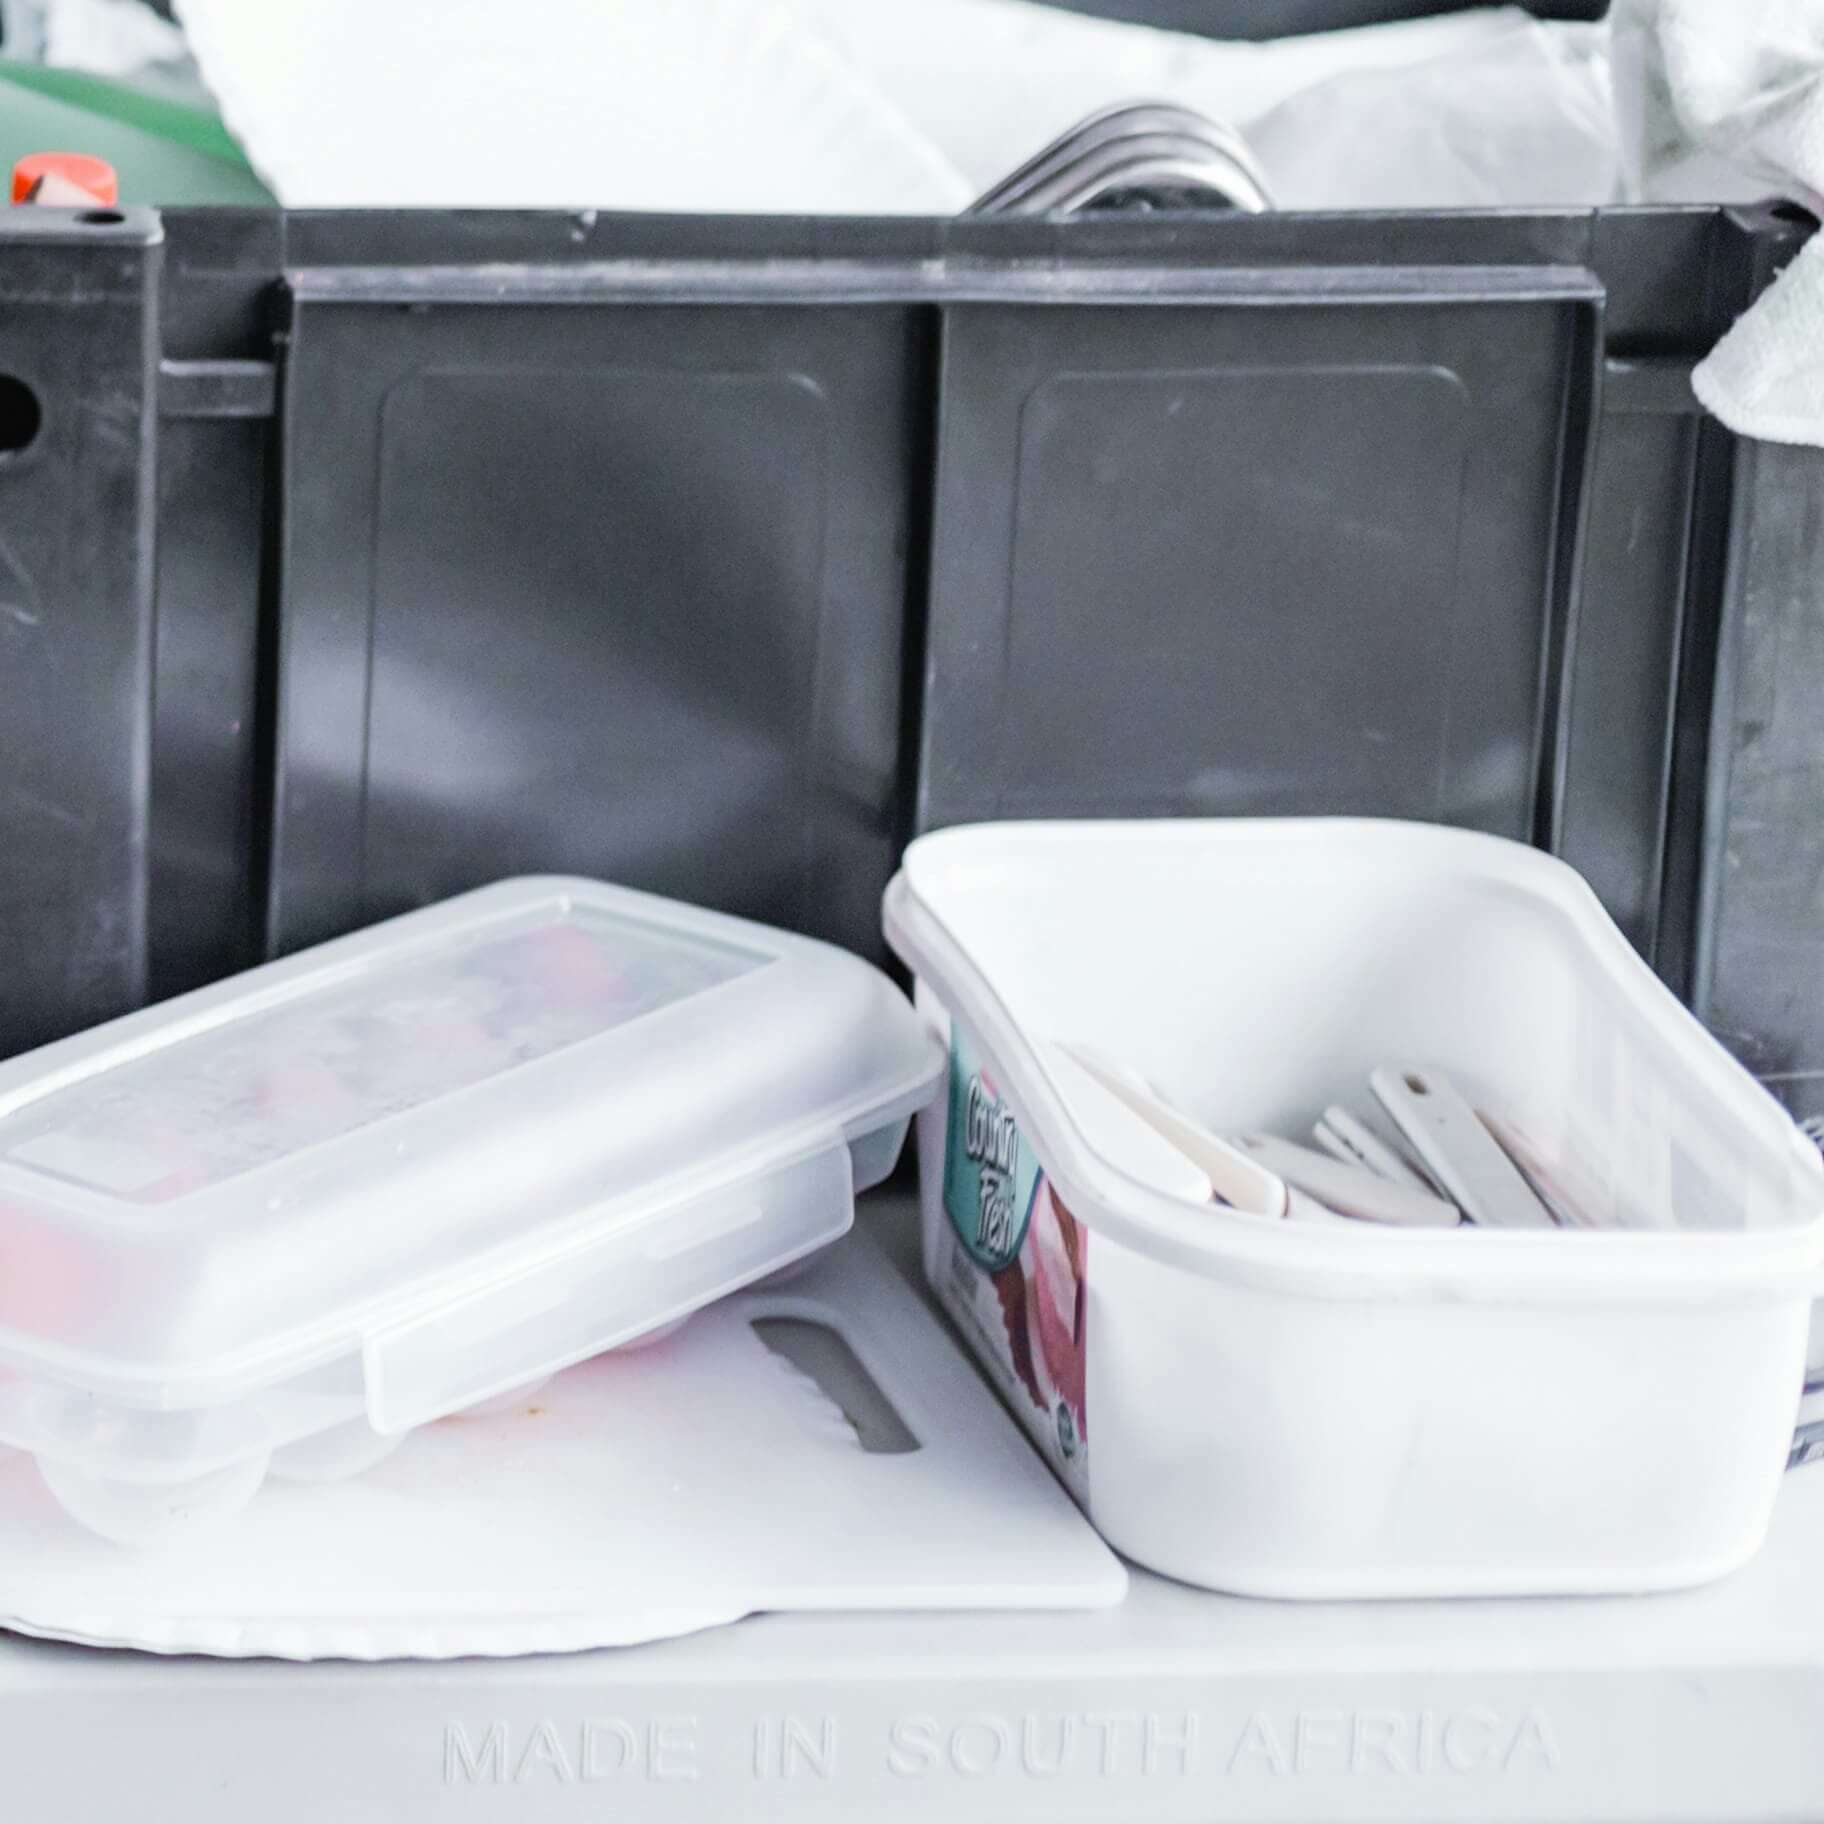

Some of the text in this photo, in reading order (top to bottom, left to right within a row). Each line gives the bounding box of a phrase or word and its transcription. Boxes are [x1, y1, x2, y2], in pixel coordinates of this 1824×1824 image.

[441, 1707, 1565, 1784] MADE IN SOUTH AFRICA
